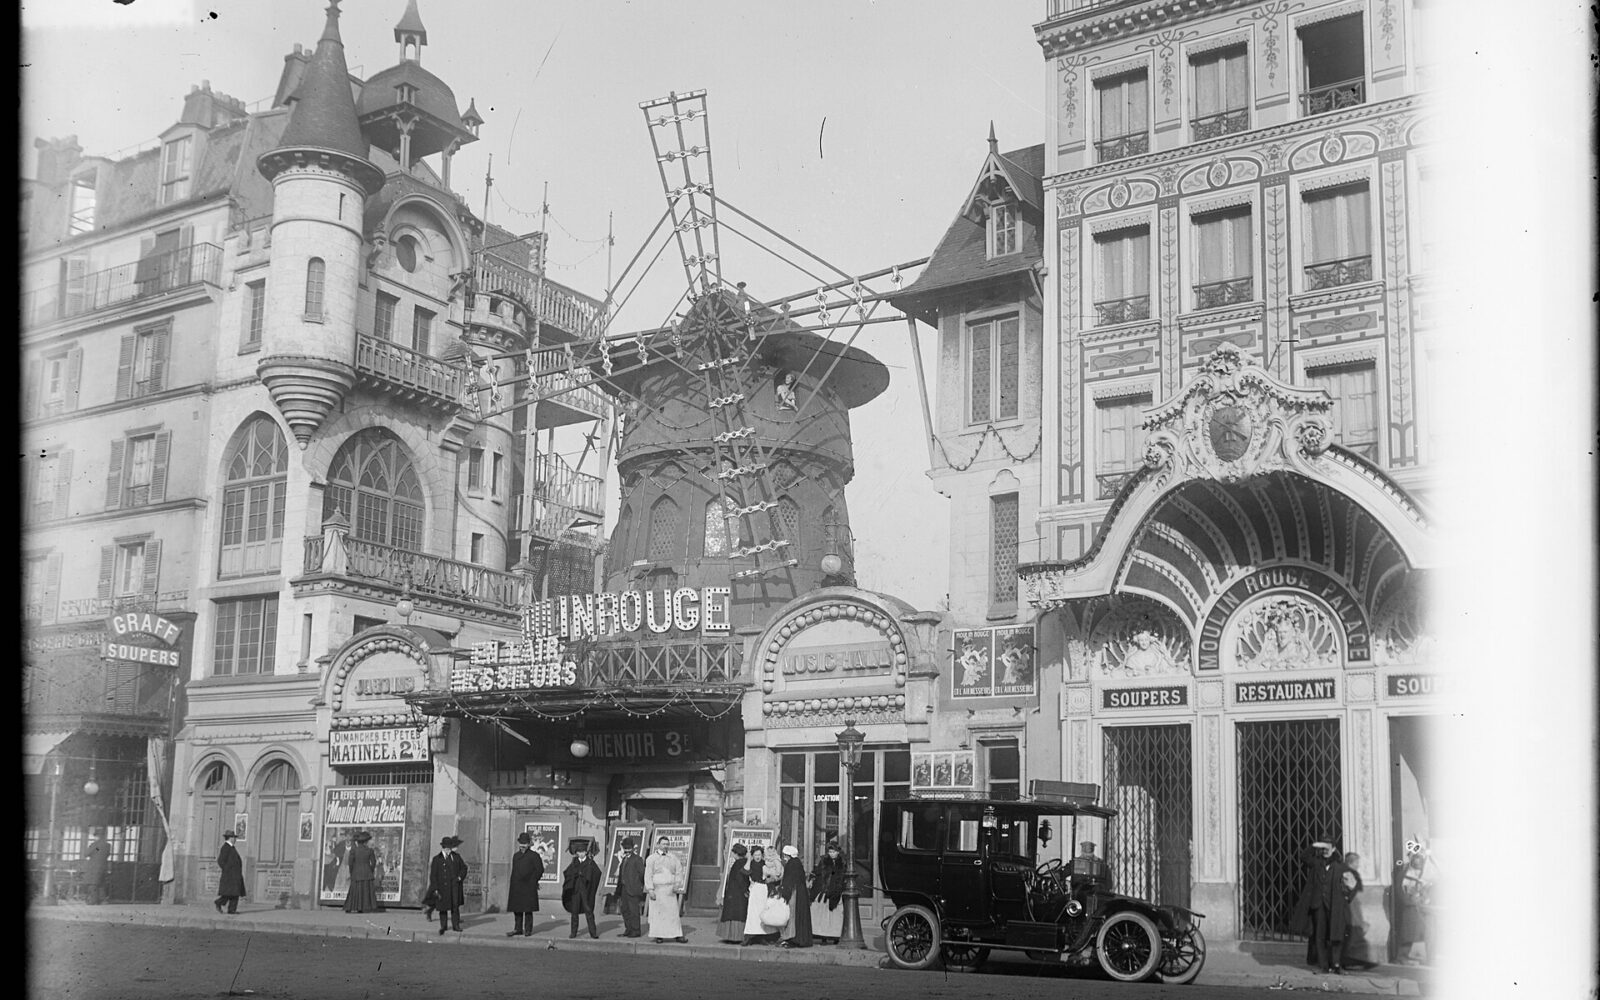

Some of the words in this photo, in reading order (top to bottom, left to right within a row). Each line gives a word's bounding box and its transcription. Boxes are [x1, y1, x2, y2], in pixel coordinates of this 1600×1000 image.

[113, 612, 178, 640] GRAFF
[1200, 591, 1242, 669] MOULIN
[1244, 568, 1310, 595] ROUGE
[1321, 582, 1369, 660] PALACE
[108, 643, 178, 666] SOUPERS
[1110, 689, 1181, 707] SOUPERS
[1238, 682, 1333, 702] RESTAURANT
[382, 731, 391, 741] ET
[332, 790, 339, 800] LA
[813, 794, 840, 802] LOCATION
[327, 799, 356, 824] Moulin
[354, 799, 380, 825] Rouge
[378, 799, 405, 823] Palace
